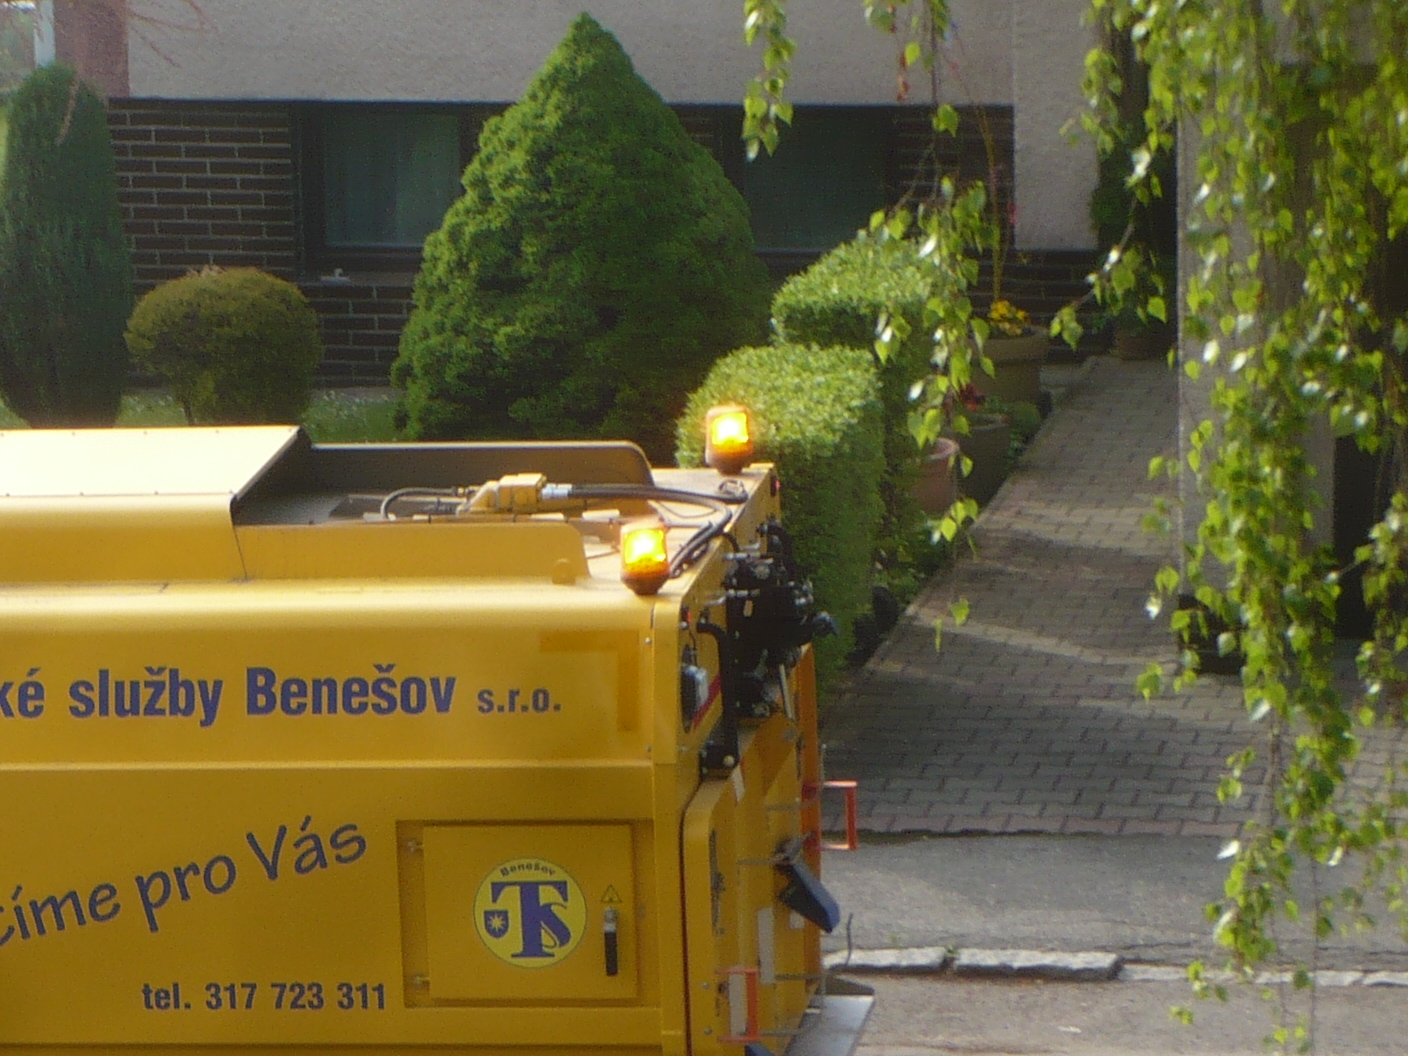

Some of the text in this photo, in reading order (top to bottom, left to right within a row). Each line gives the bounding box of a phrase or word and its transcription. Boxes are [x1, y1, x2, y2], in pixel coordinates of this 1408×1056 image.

[68, 666, 223, 727] služby
[246, 663, 456, 715] Benešov
[477, 688, 561, 713] s.r.o.
[135, 854, 237, 932] pro
[245, 815, 367, 880] Vás
[142, 982, 386, 1010] tel. 317 723 311
